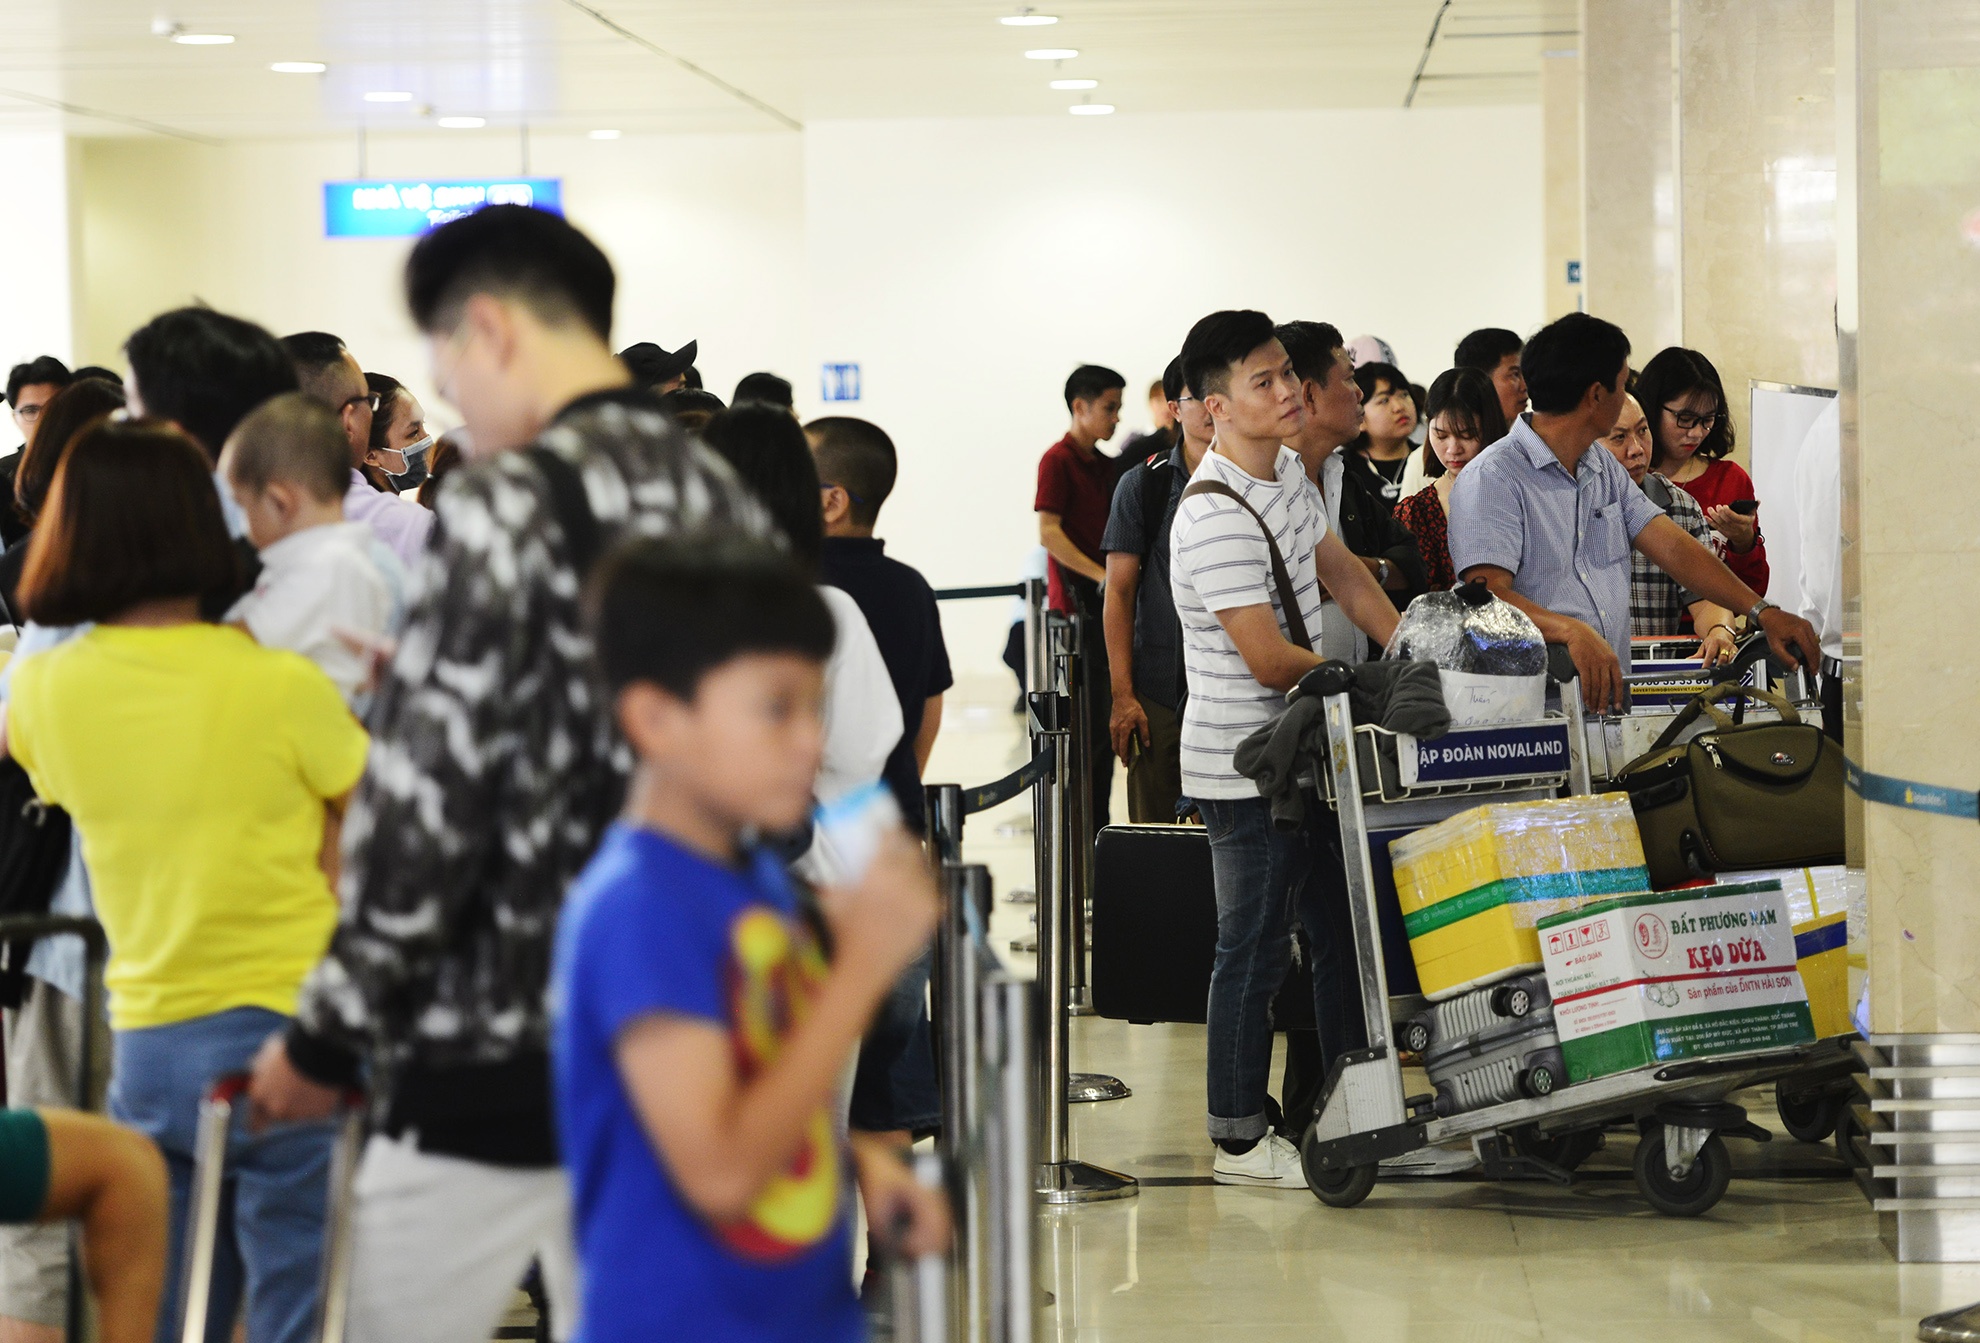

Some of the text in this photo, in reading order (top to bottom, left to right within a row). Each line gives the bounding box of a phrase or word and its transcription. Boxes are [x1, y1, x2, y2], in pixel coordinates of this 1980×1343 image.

[1418, 740, 1563, 768] ẬP ĐOÀN NOVALAND
[1671, 910, 1777, 934] ĐẤT PHƯƠNG NAM
[1687, 936, 1766, 972] KẸO DỪA
[1688, 987, 1702, 1000] Sản
[1704, 983, 1724, 1000] phẩm
[1726, 982, 1738, 994] của
[1762, 975, 1775, 990] HẢI
[1777, 976, 1792, 988] SƠN
